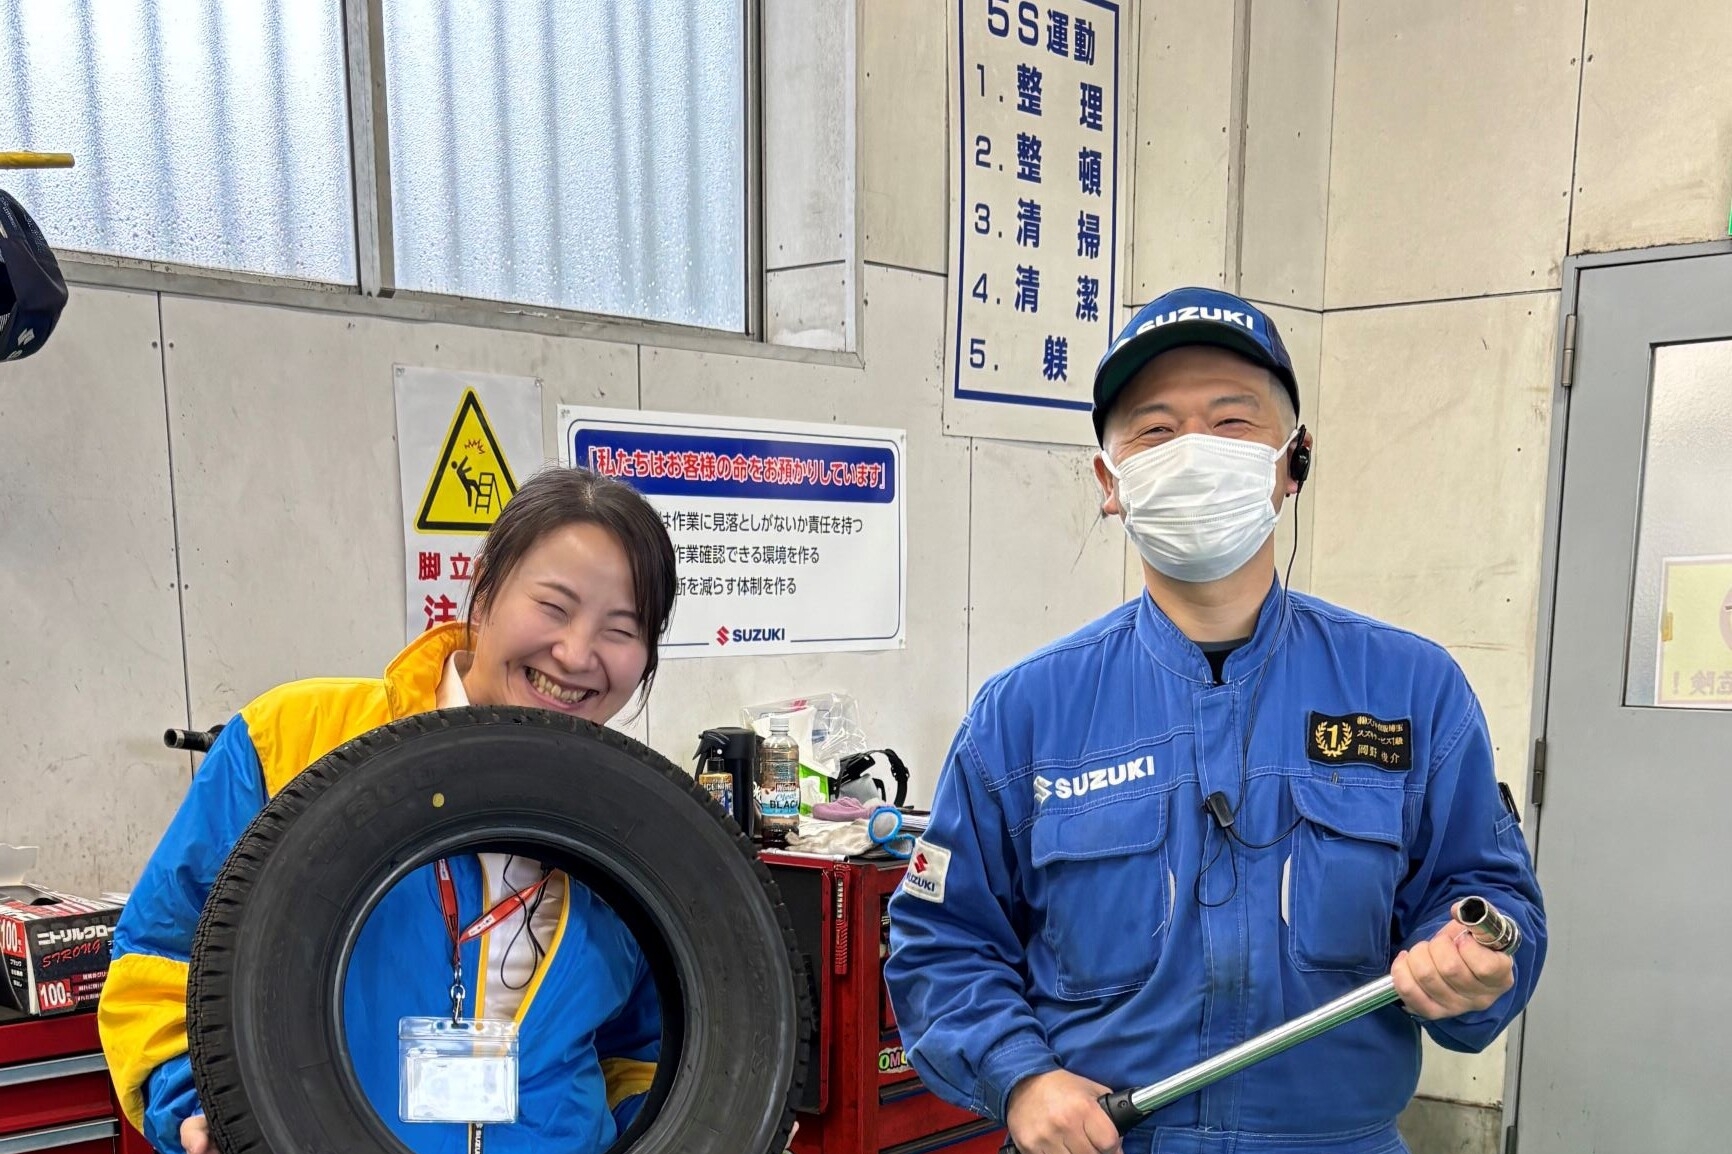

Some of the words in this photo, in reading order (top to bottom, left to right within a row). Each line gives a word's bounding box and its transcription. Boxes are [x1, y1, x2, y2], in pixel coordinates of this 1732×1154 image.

[988, 0, 1095, 66] 5S運動
[1136, 306, 1253, 336] SUZUKI
[732, 627, 786, 643] SUZUKI
[1326, 724, 1339, 748] 1
[1054, 755, 1156, 800] SUZUKI
[42, 938, 102, 968] STRONG
